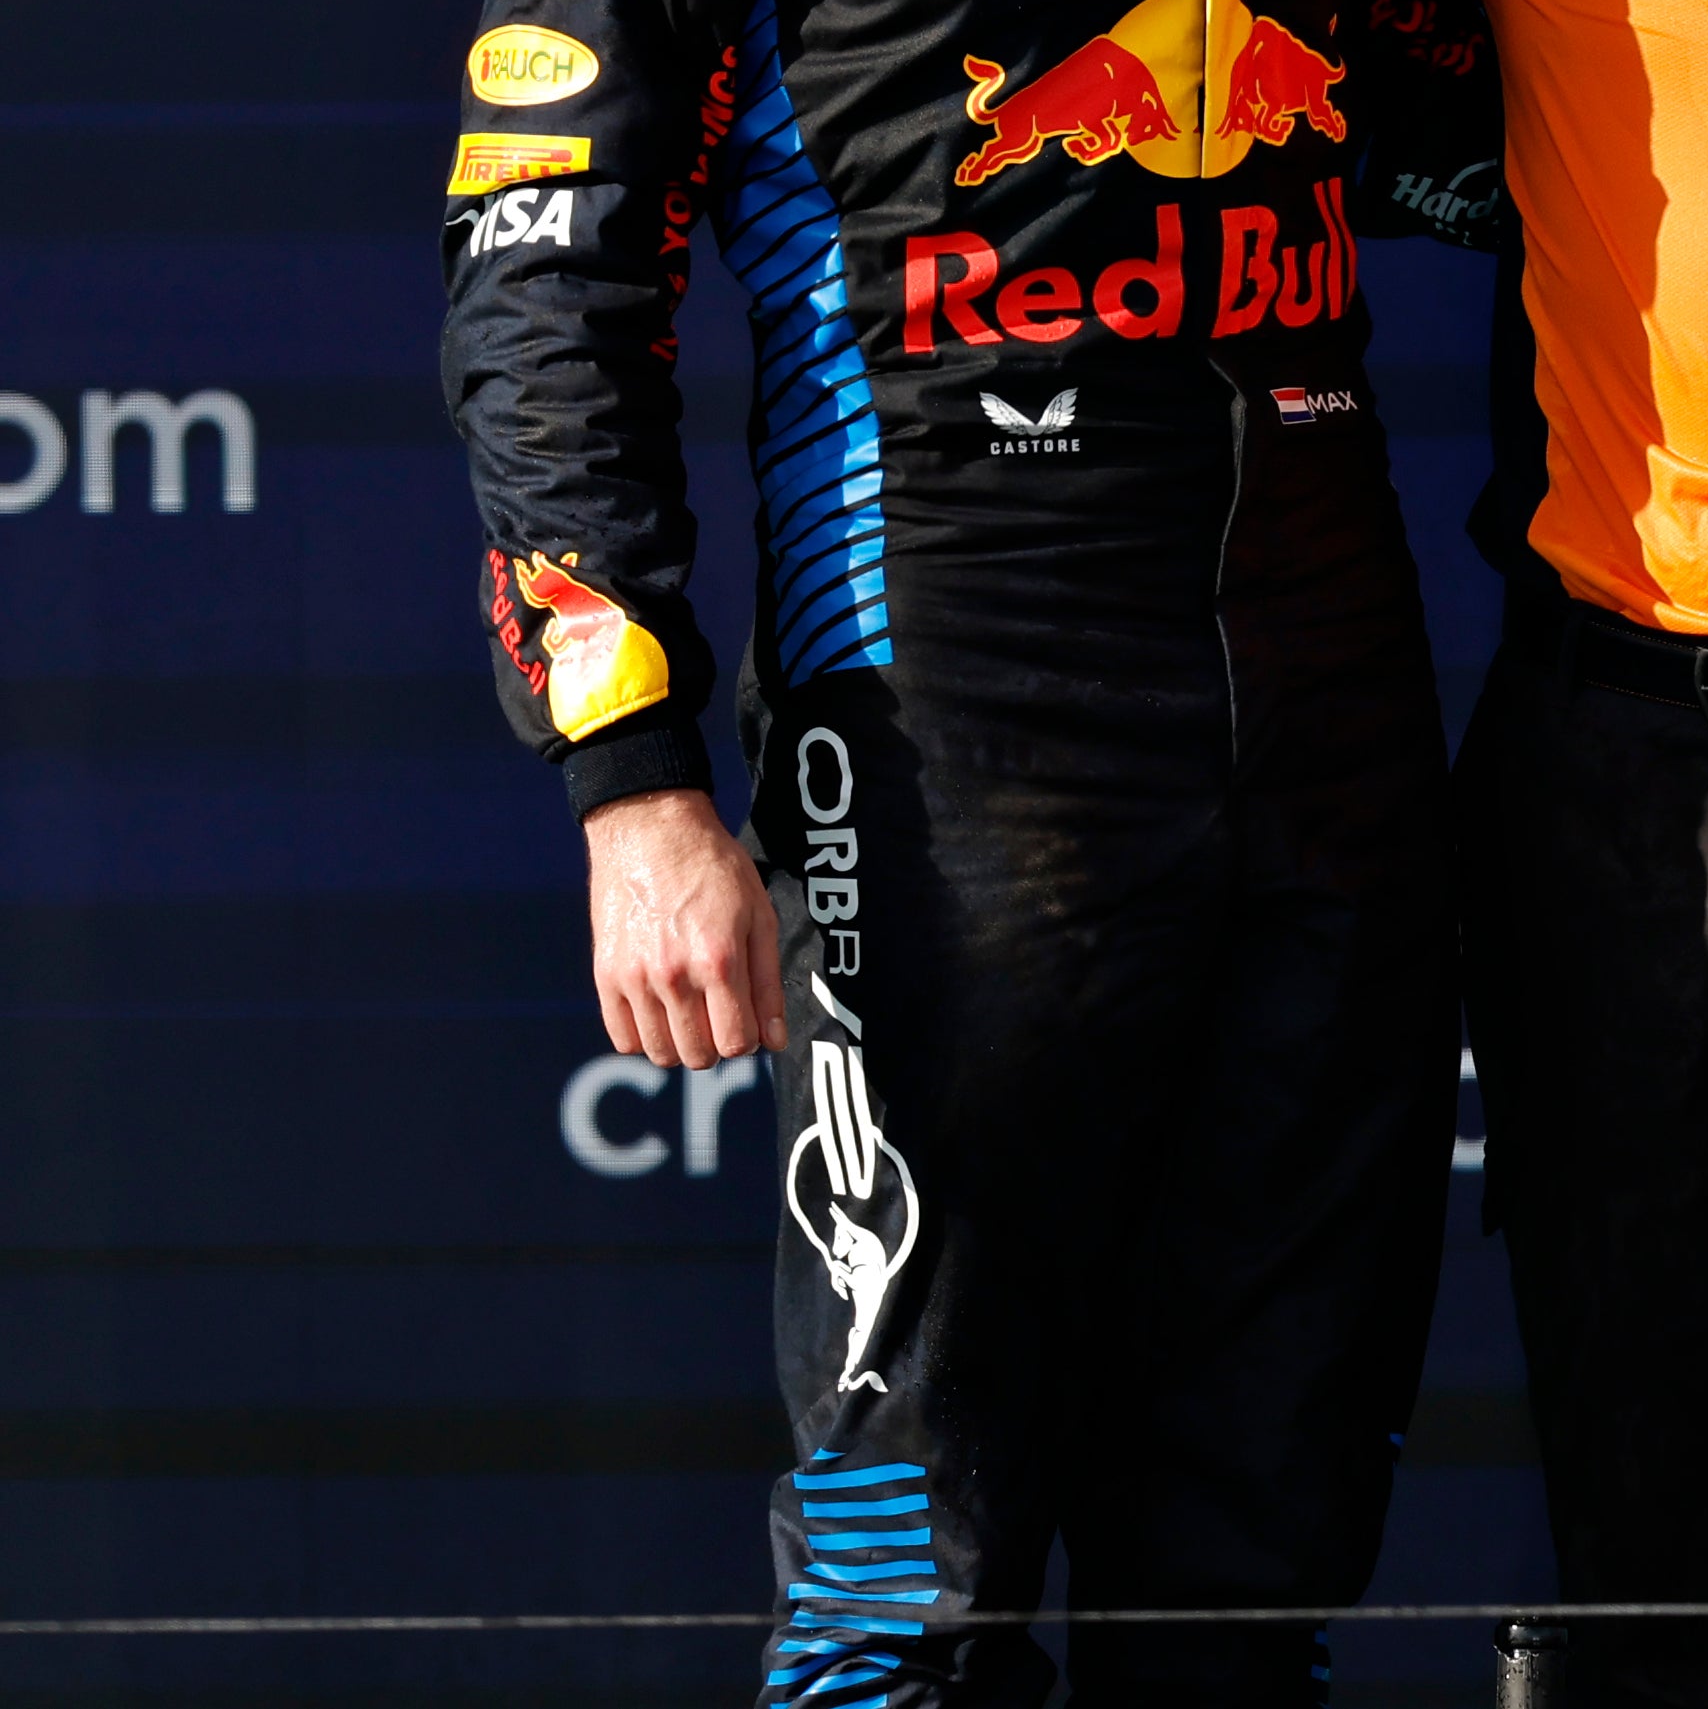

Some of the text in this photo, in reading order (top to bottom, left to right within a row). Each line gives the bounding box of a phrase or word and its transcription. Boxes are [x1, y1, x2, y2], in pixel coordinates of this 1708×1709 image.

[490, 49, 574, 83] RAUCH
[467, 188, 574, 258] VISA
[902, 176, 1359, 355] Red Bull
[1306, 390, 1360, 414] MAX
[990, 438, 1081, 455] CASTORE
